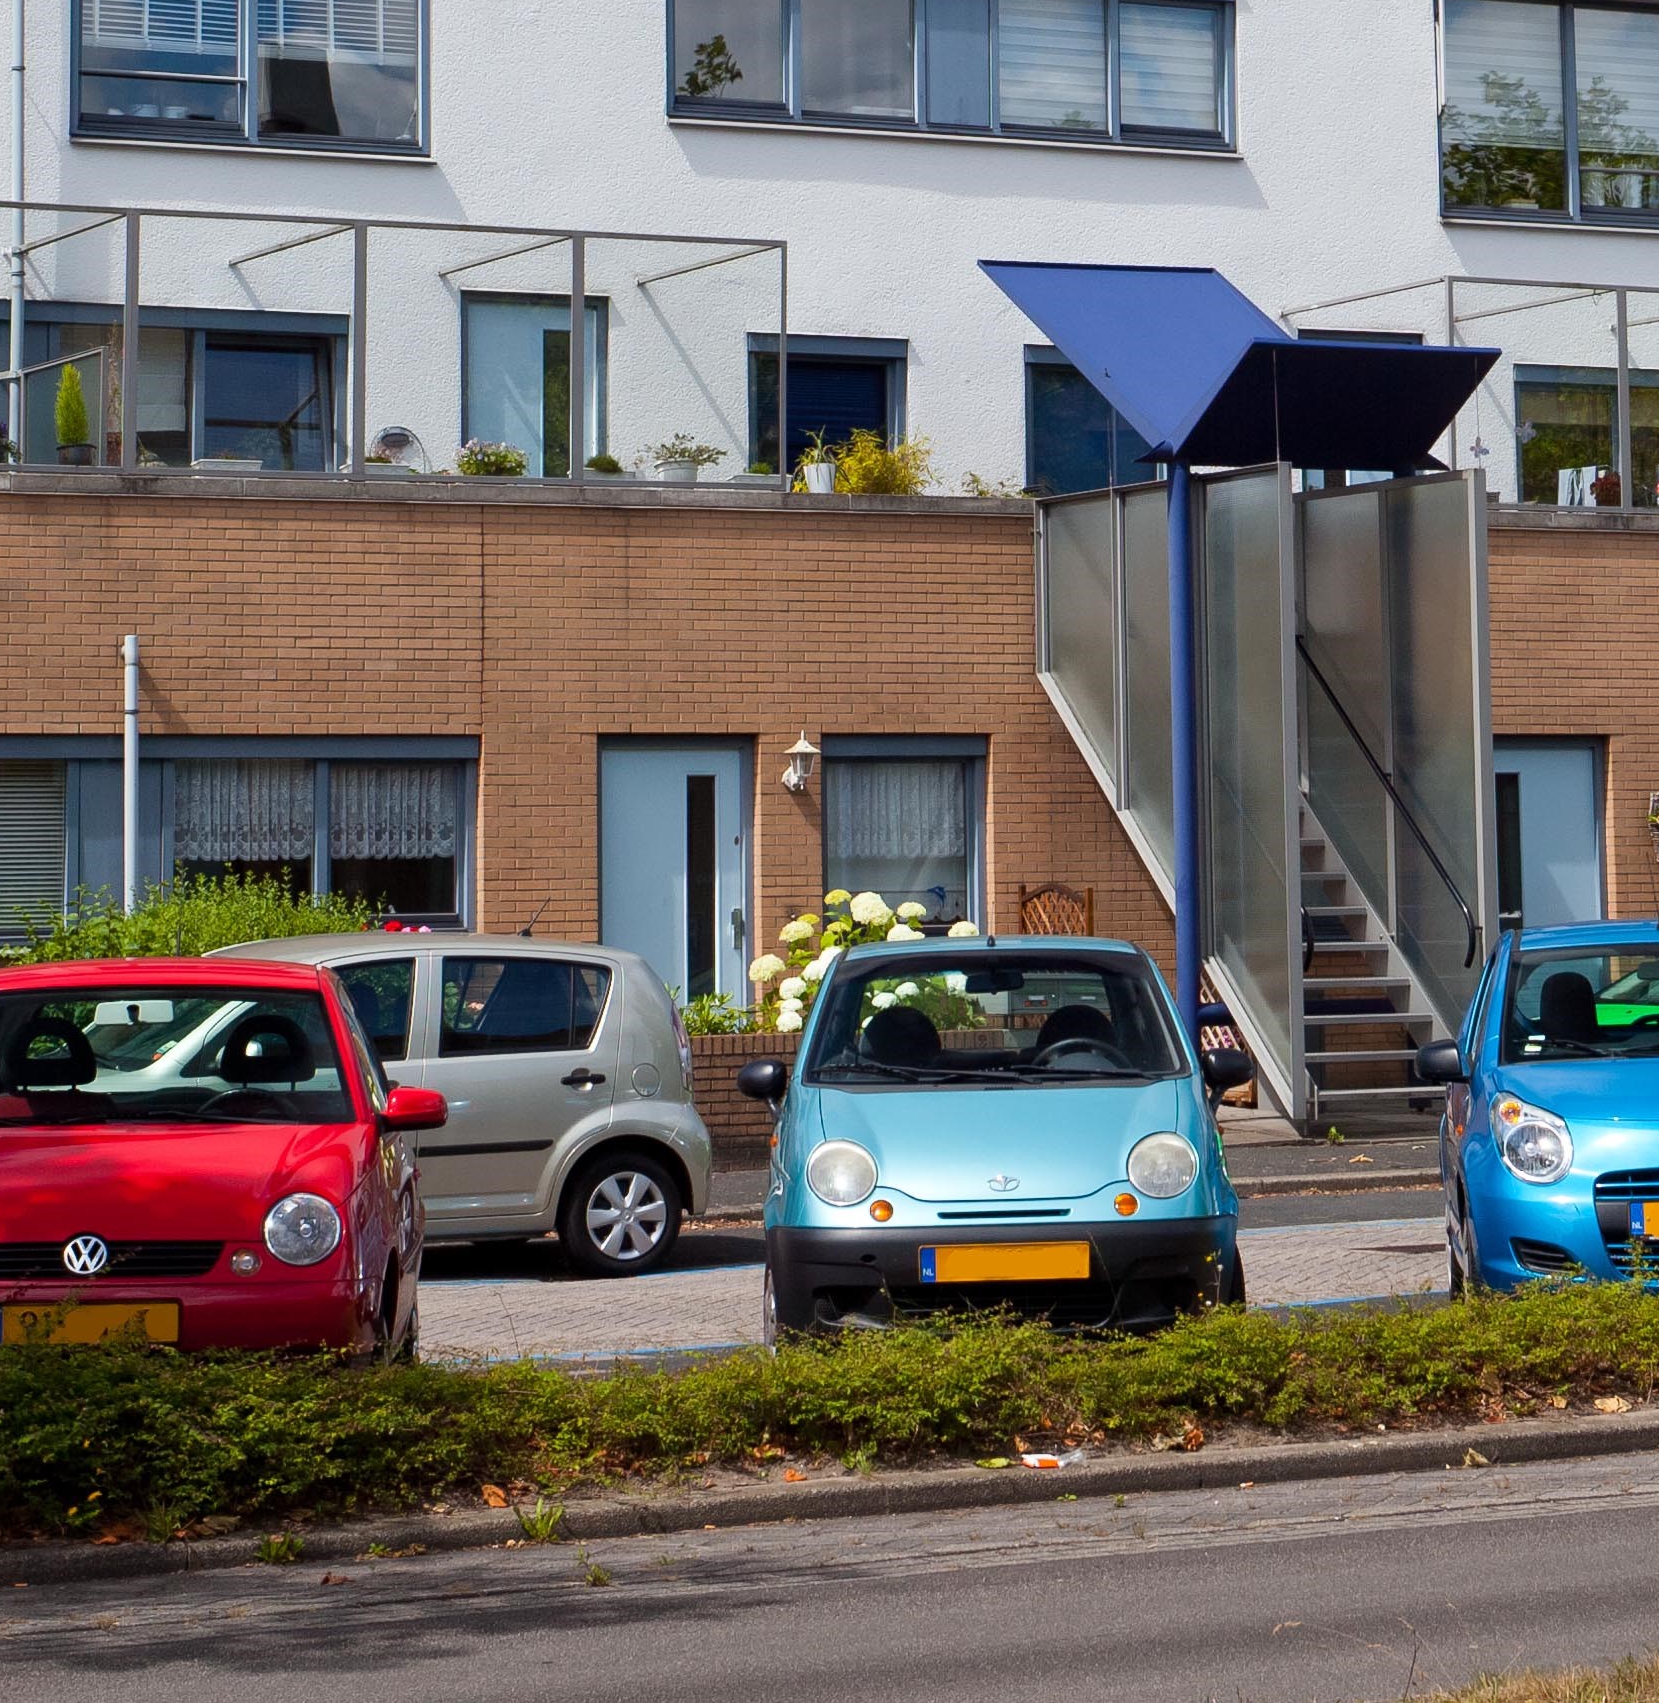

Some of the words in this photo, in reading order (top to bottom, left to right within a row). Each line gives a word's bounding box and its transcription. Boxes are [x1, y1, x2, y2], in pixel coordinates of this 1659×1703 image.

[1631, 1221, 1643, 1229] NL
[63, 1235, 107, 1275] VW
[922, 1268, 934, 1277] NL
